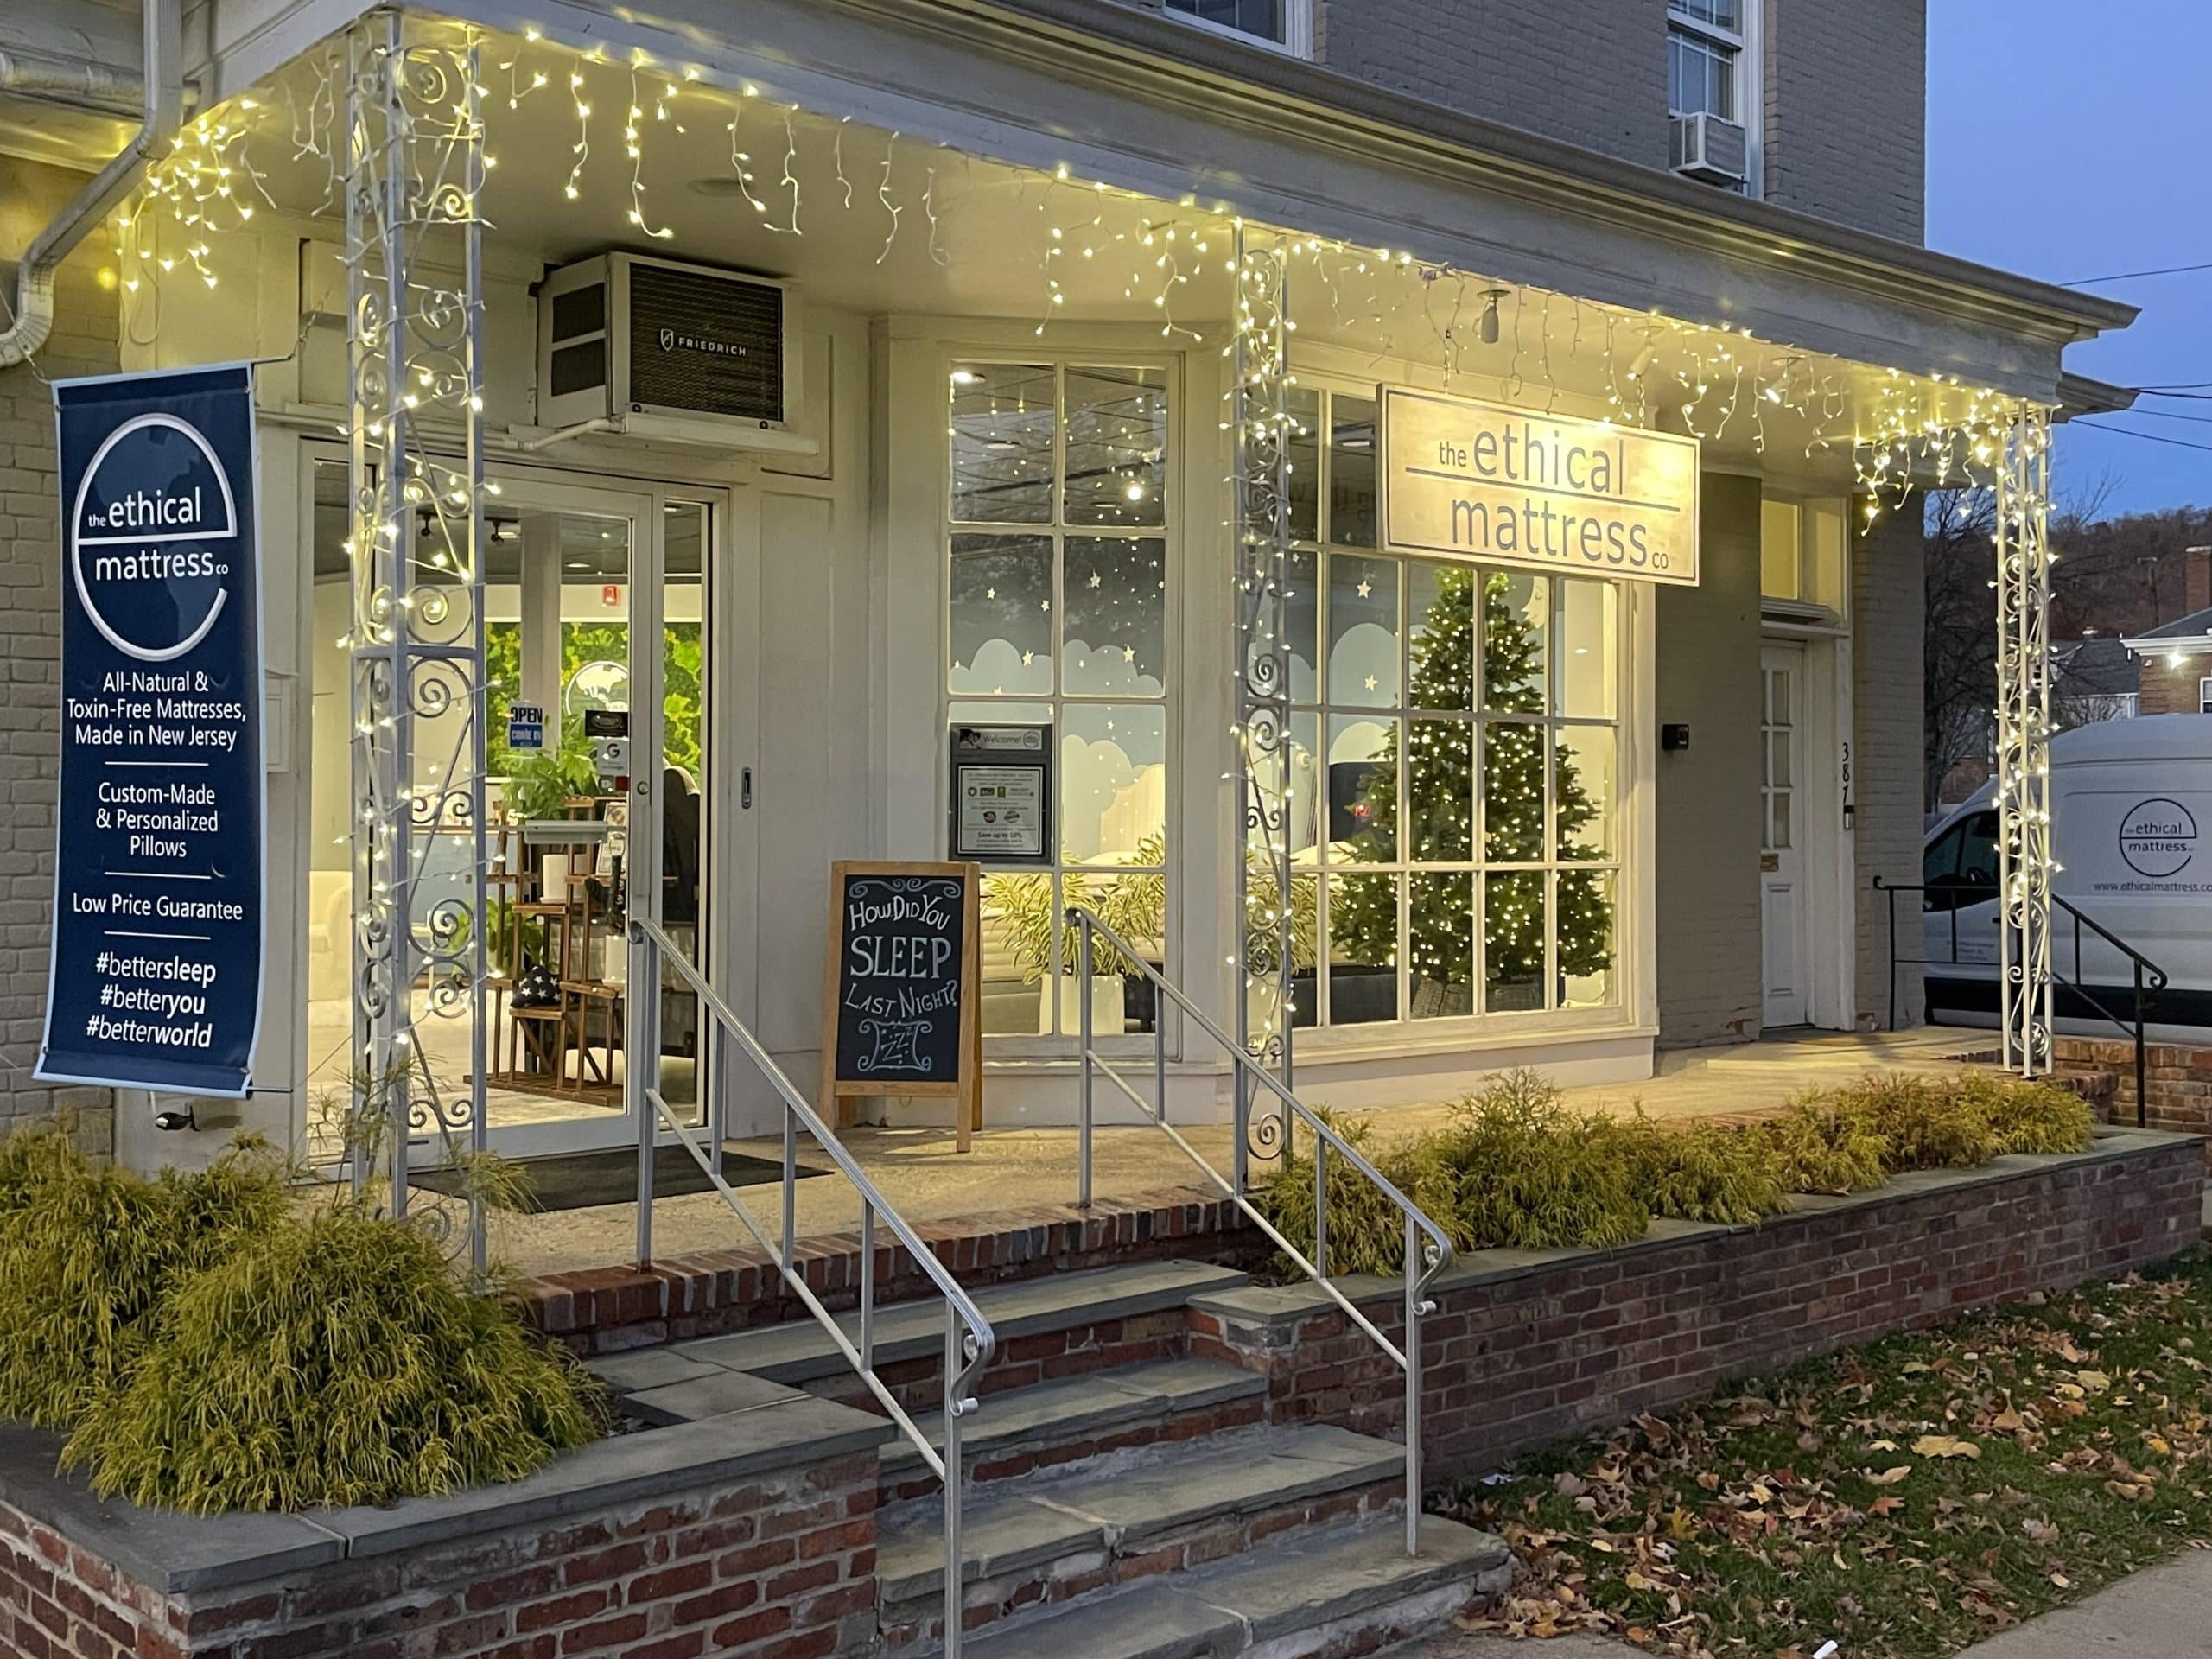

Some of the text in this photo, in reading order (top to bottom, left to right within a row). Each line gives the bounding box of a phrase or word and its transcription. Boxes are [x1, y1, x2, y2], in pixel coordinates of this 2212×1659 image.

[678, 336, 747, 356] FRIEDRICH
[1439, 423, 1624, 496] the ethical
[88, 486, 200, 528] the ethical
[1451, 498, 1669, 570] mattress co
[95, 549, 229, 582] mattress co
[103, 671, 209, 692] All-Natural &
[67, 698, 246, 722] Toxin-Free Mattresses,
[510, 707, 543, 723] OPEN
[75, 723, 238, 752] Made in New Jersey
[99, 782, 216, 804] Custom-Made
[96, 808, 219, 832] & Personalized
[2135, 822, 2182, 835] ethical
[130, 835, 188, 858] Pillows
[2128, 842, 2188, 852] mattress
[73, 893, 243, 920] Low Price Guarantee
[96, 951, 217, 988] #bettersleep
[850, 935, 951, 979] SLEEP
[100, 983, 206, 1019] #betteryou
[86, 1014, 213, 1048] #betterworld
